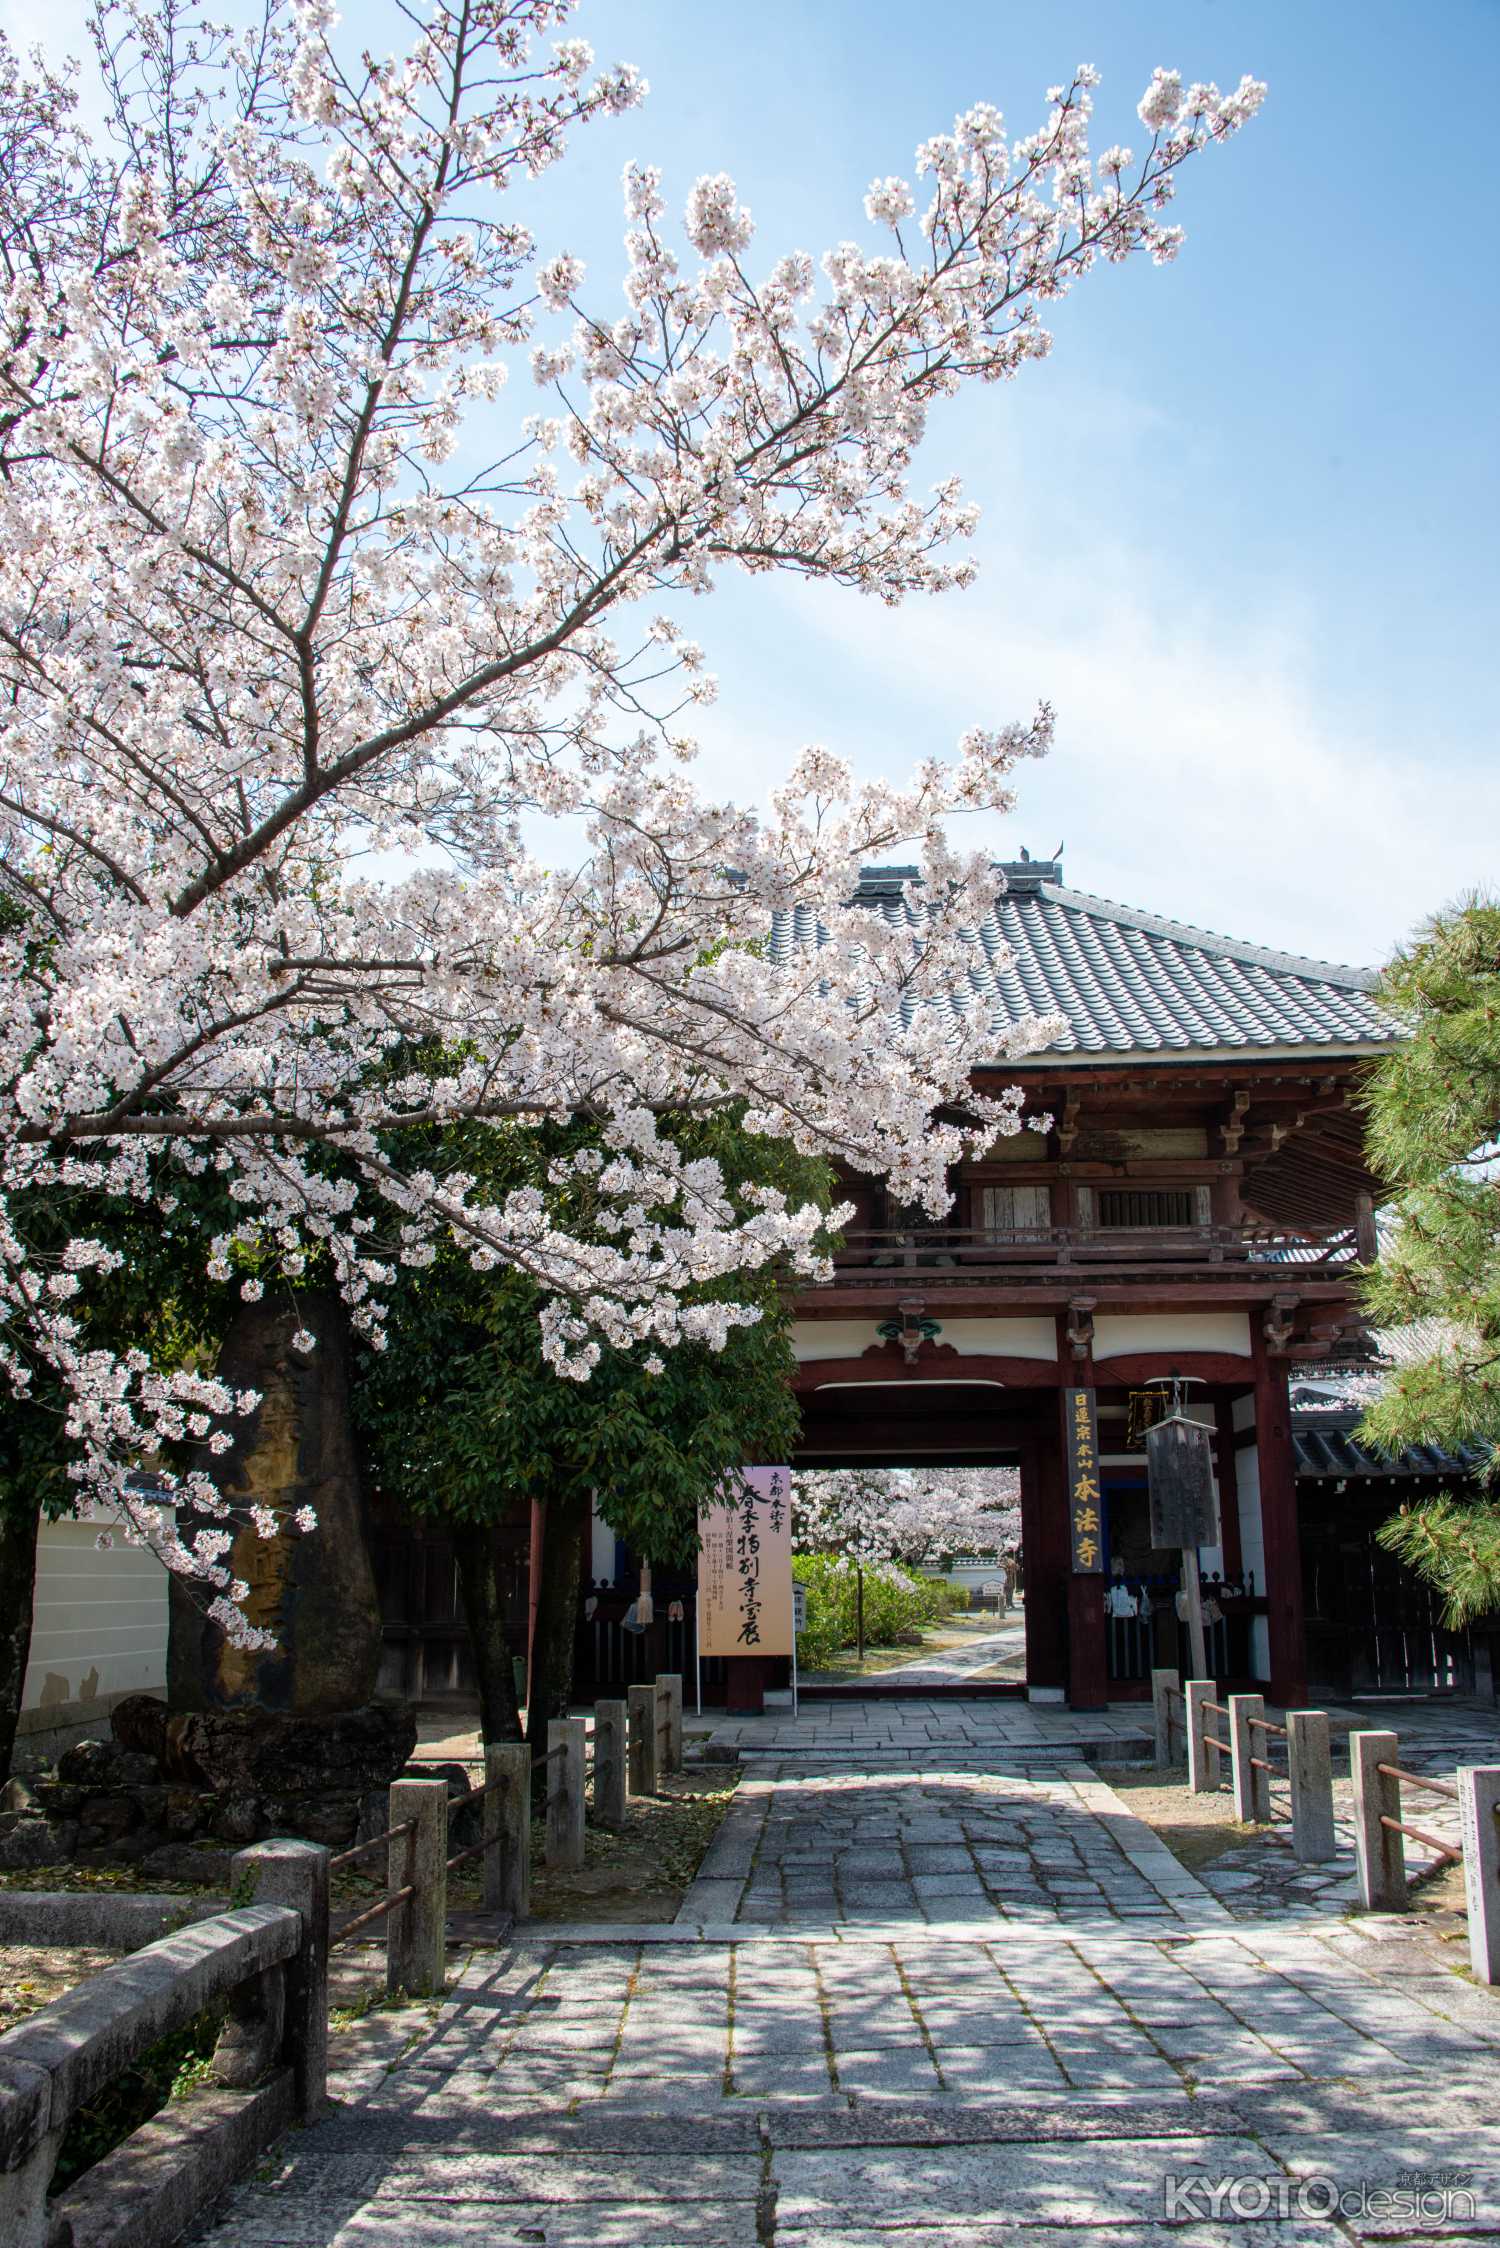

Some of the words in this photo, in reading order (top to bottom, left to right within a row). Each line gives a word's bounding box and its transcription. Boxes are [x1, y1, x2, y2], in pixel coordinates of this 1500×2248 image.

[769, 1472, 786, 1534] 京都本法寺
[737, 1484, 770, 1645] 春季特別寺宝展
